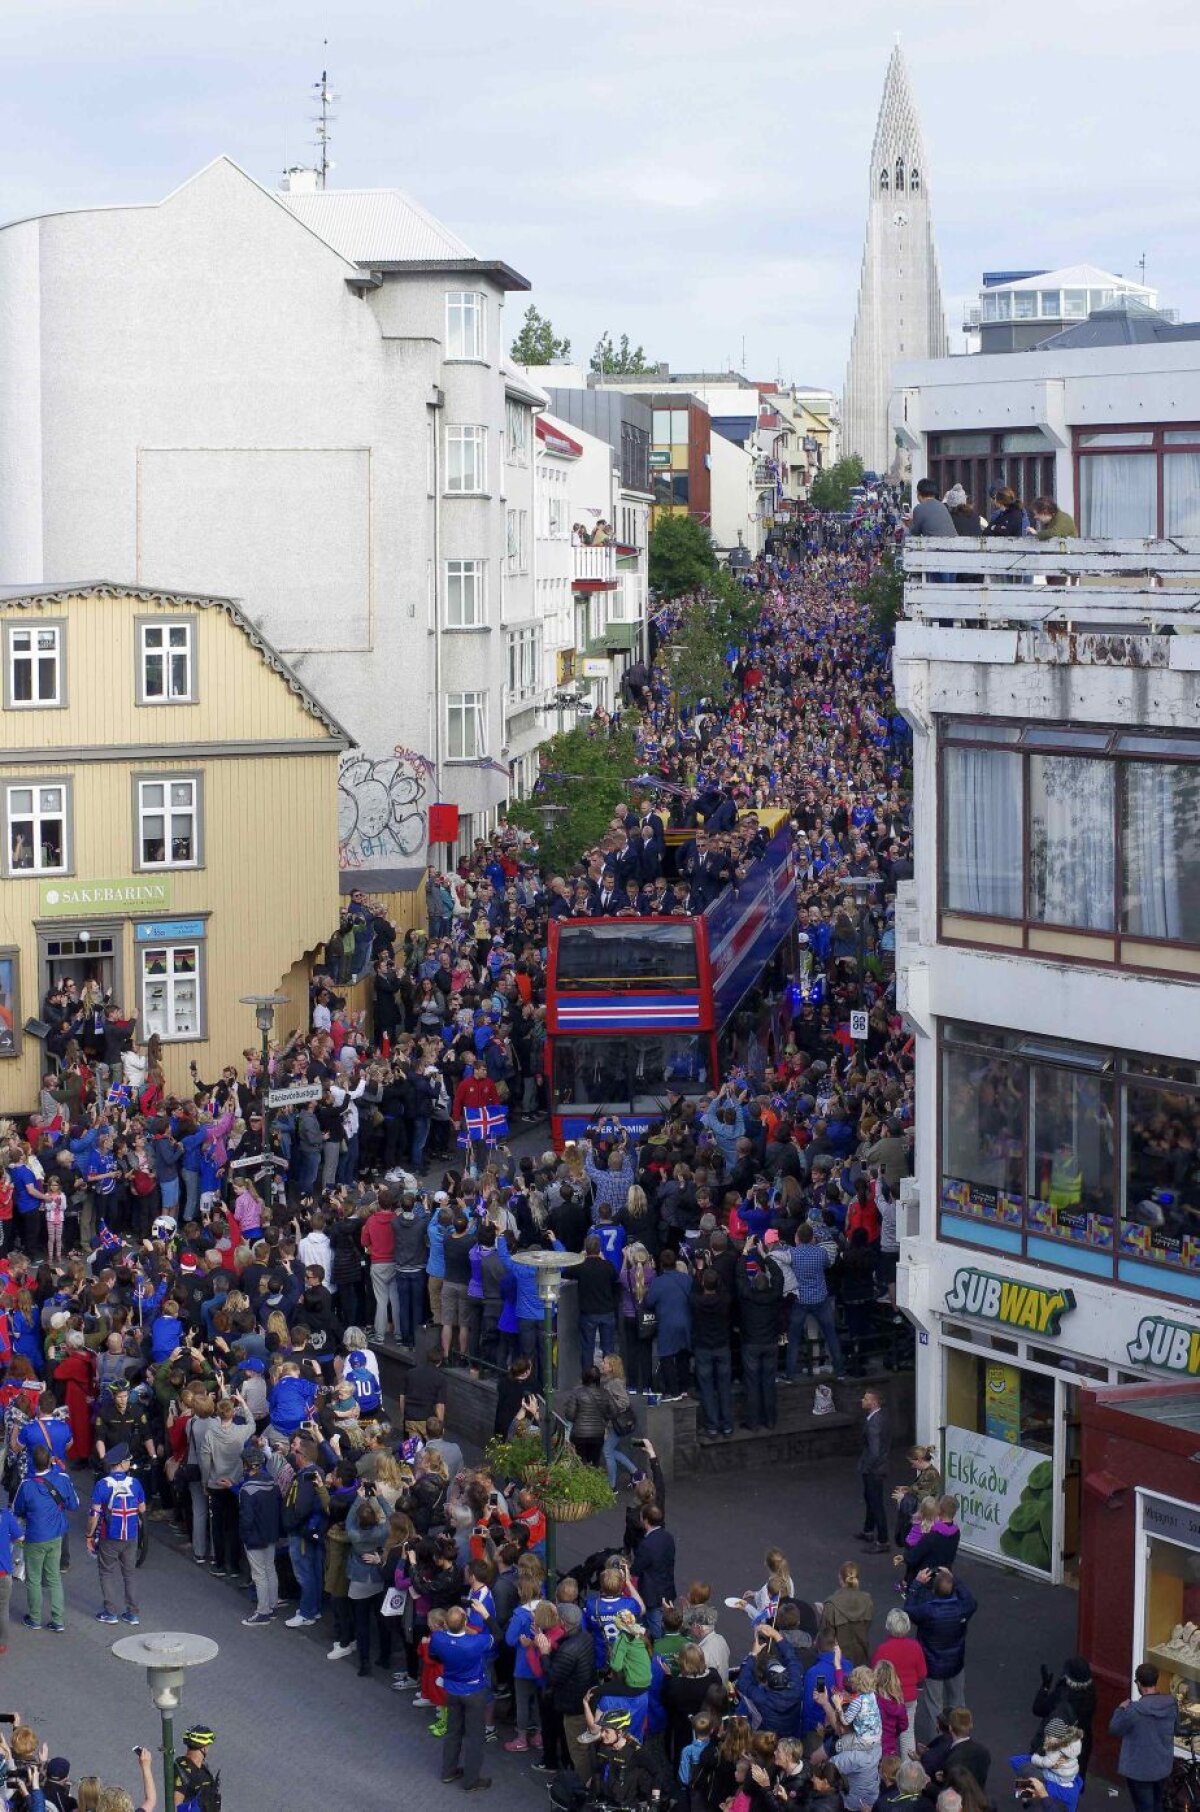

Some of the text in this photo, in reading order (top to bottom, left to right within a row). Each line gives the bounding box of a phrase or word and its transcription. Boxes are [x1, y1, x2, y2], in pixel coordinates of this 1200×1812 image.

[62, 885, 165, 903] SAKEBARINN
[603, 1229, 617, 1251] 7
[947, 1271, 1064, 1332] SUBWAY
[355, 1380, 371, 1397] 10
[947, 1451, 1008, 1496] Elskaðu
[954, 1489, 1001, 1526] spínat
